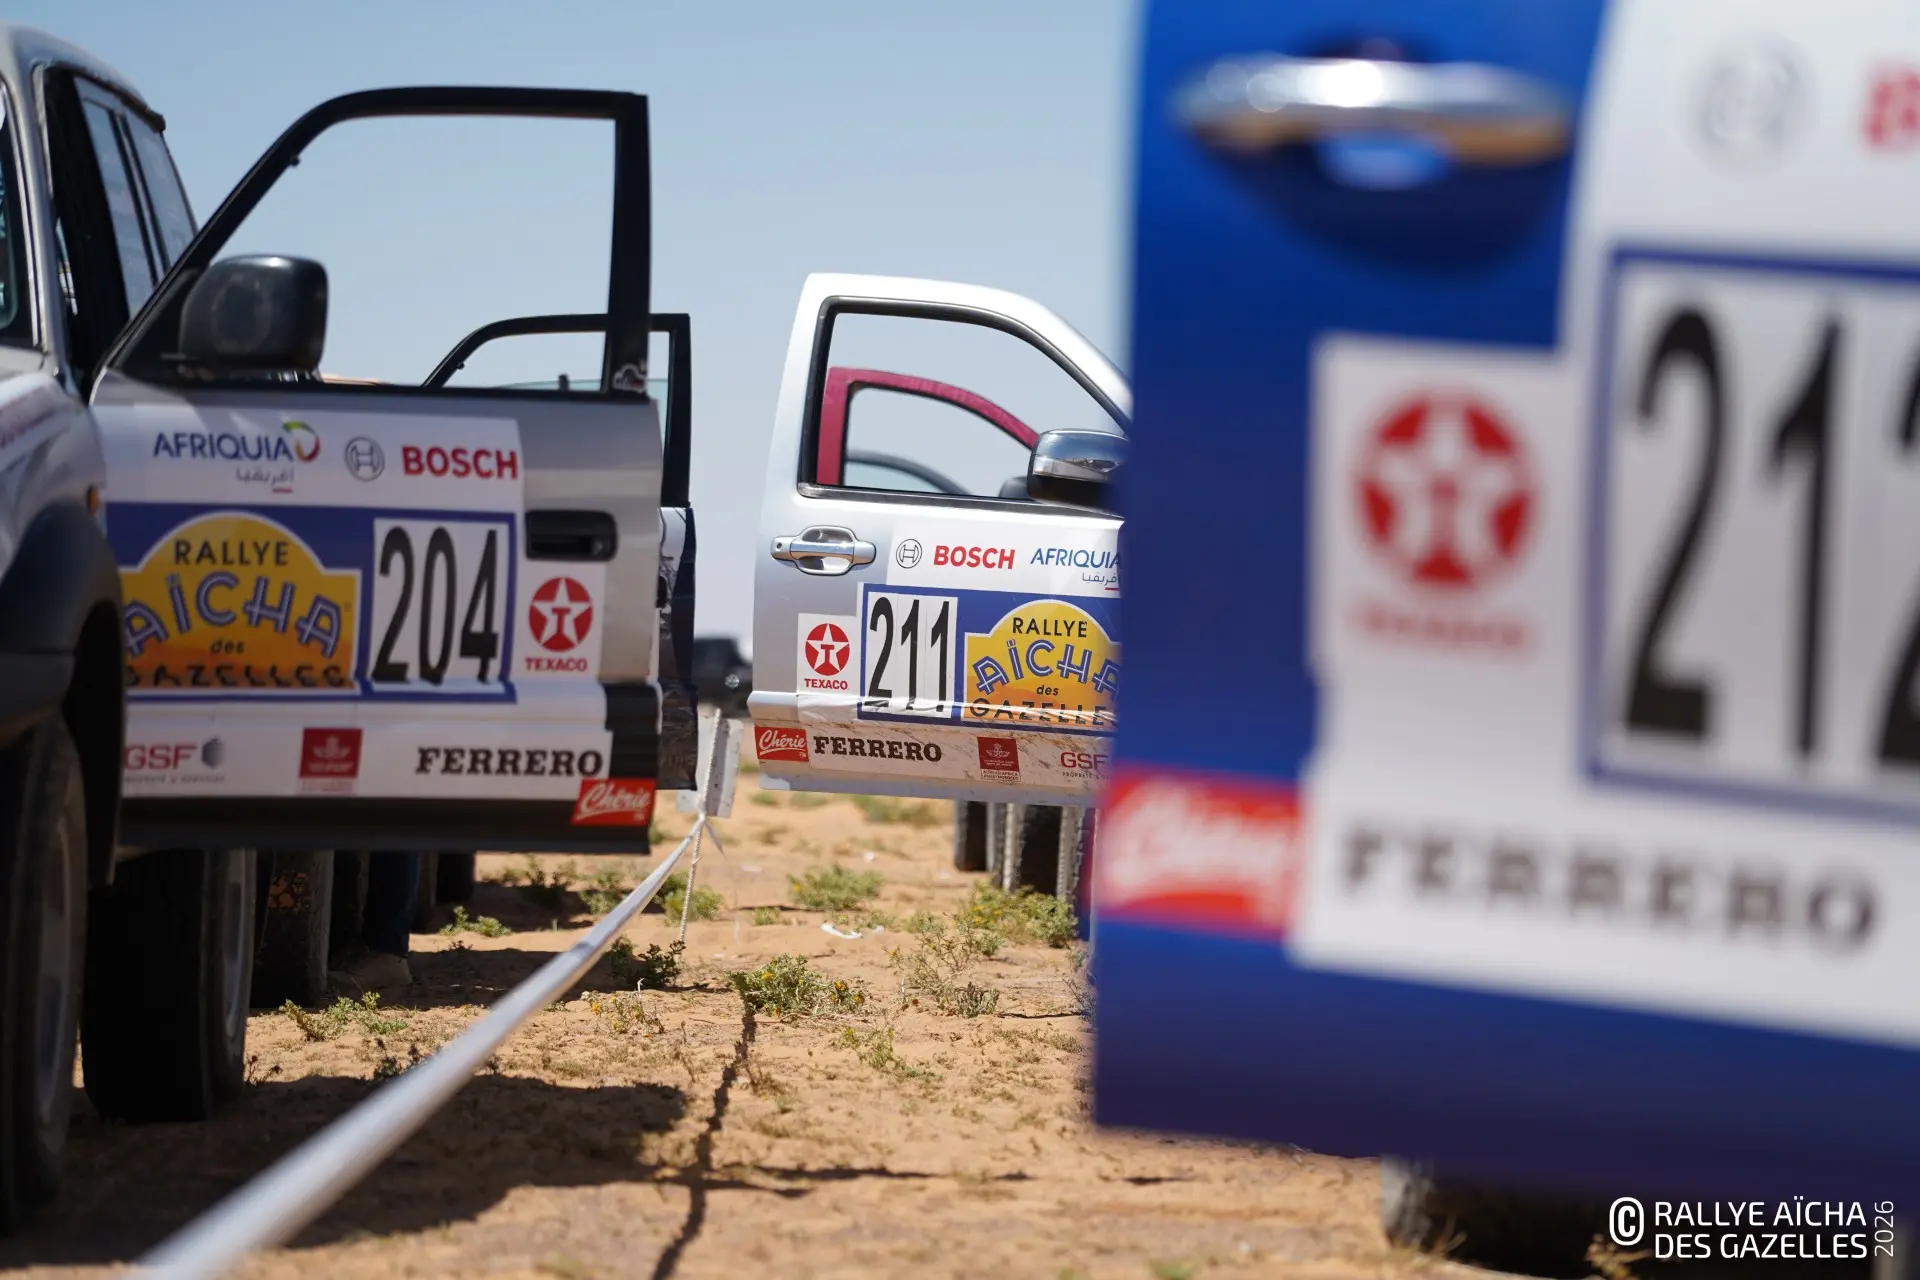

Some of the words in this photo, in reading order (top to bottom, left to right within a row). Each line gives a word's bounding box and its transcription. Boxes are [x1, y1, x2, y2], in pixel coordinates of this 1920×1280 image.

[153, 431, 294, 462] AFRIQUIA
[401, 446, 518, 479] BOSCH
[174, 540, 289, 565] RALLYE
[933, 545, 1015, 569] BOSCH
[1030, 547, 1121, 569] AFRIQUIA
[371, 526, 498, 686] 204
[1012, 617, 1088, 638] RALLYE
[210, 639, 245, 655] des
[864, 596, 949, 712] 211
[525, 657, 587, 672] TEXACO
[804, 678, 848, 691] TEXACO
[1036, 685, 1059, 696] des
[969, 698, 1112, 726] GAZELLE
[758, 729, 807, 749] Chérie
[813, 736, 942, 762] FERRERO
[123, 745, 196, 770] GSF
[415, 746, 603, 777] FERRERO
[1060, 751, 1109, 769] GSF
[579, 781, 651, 815] Chérie
